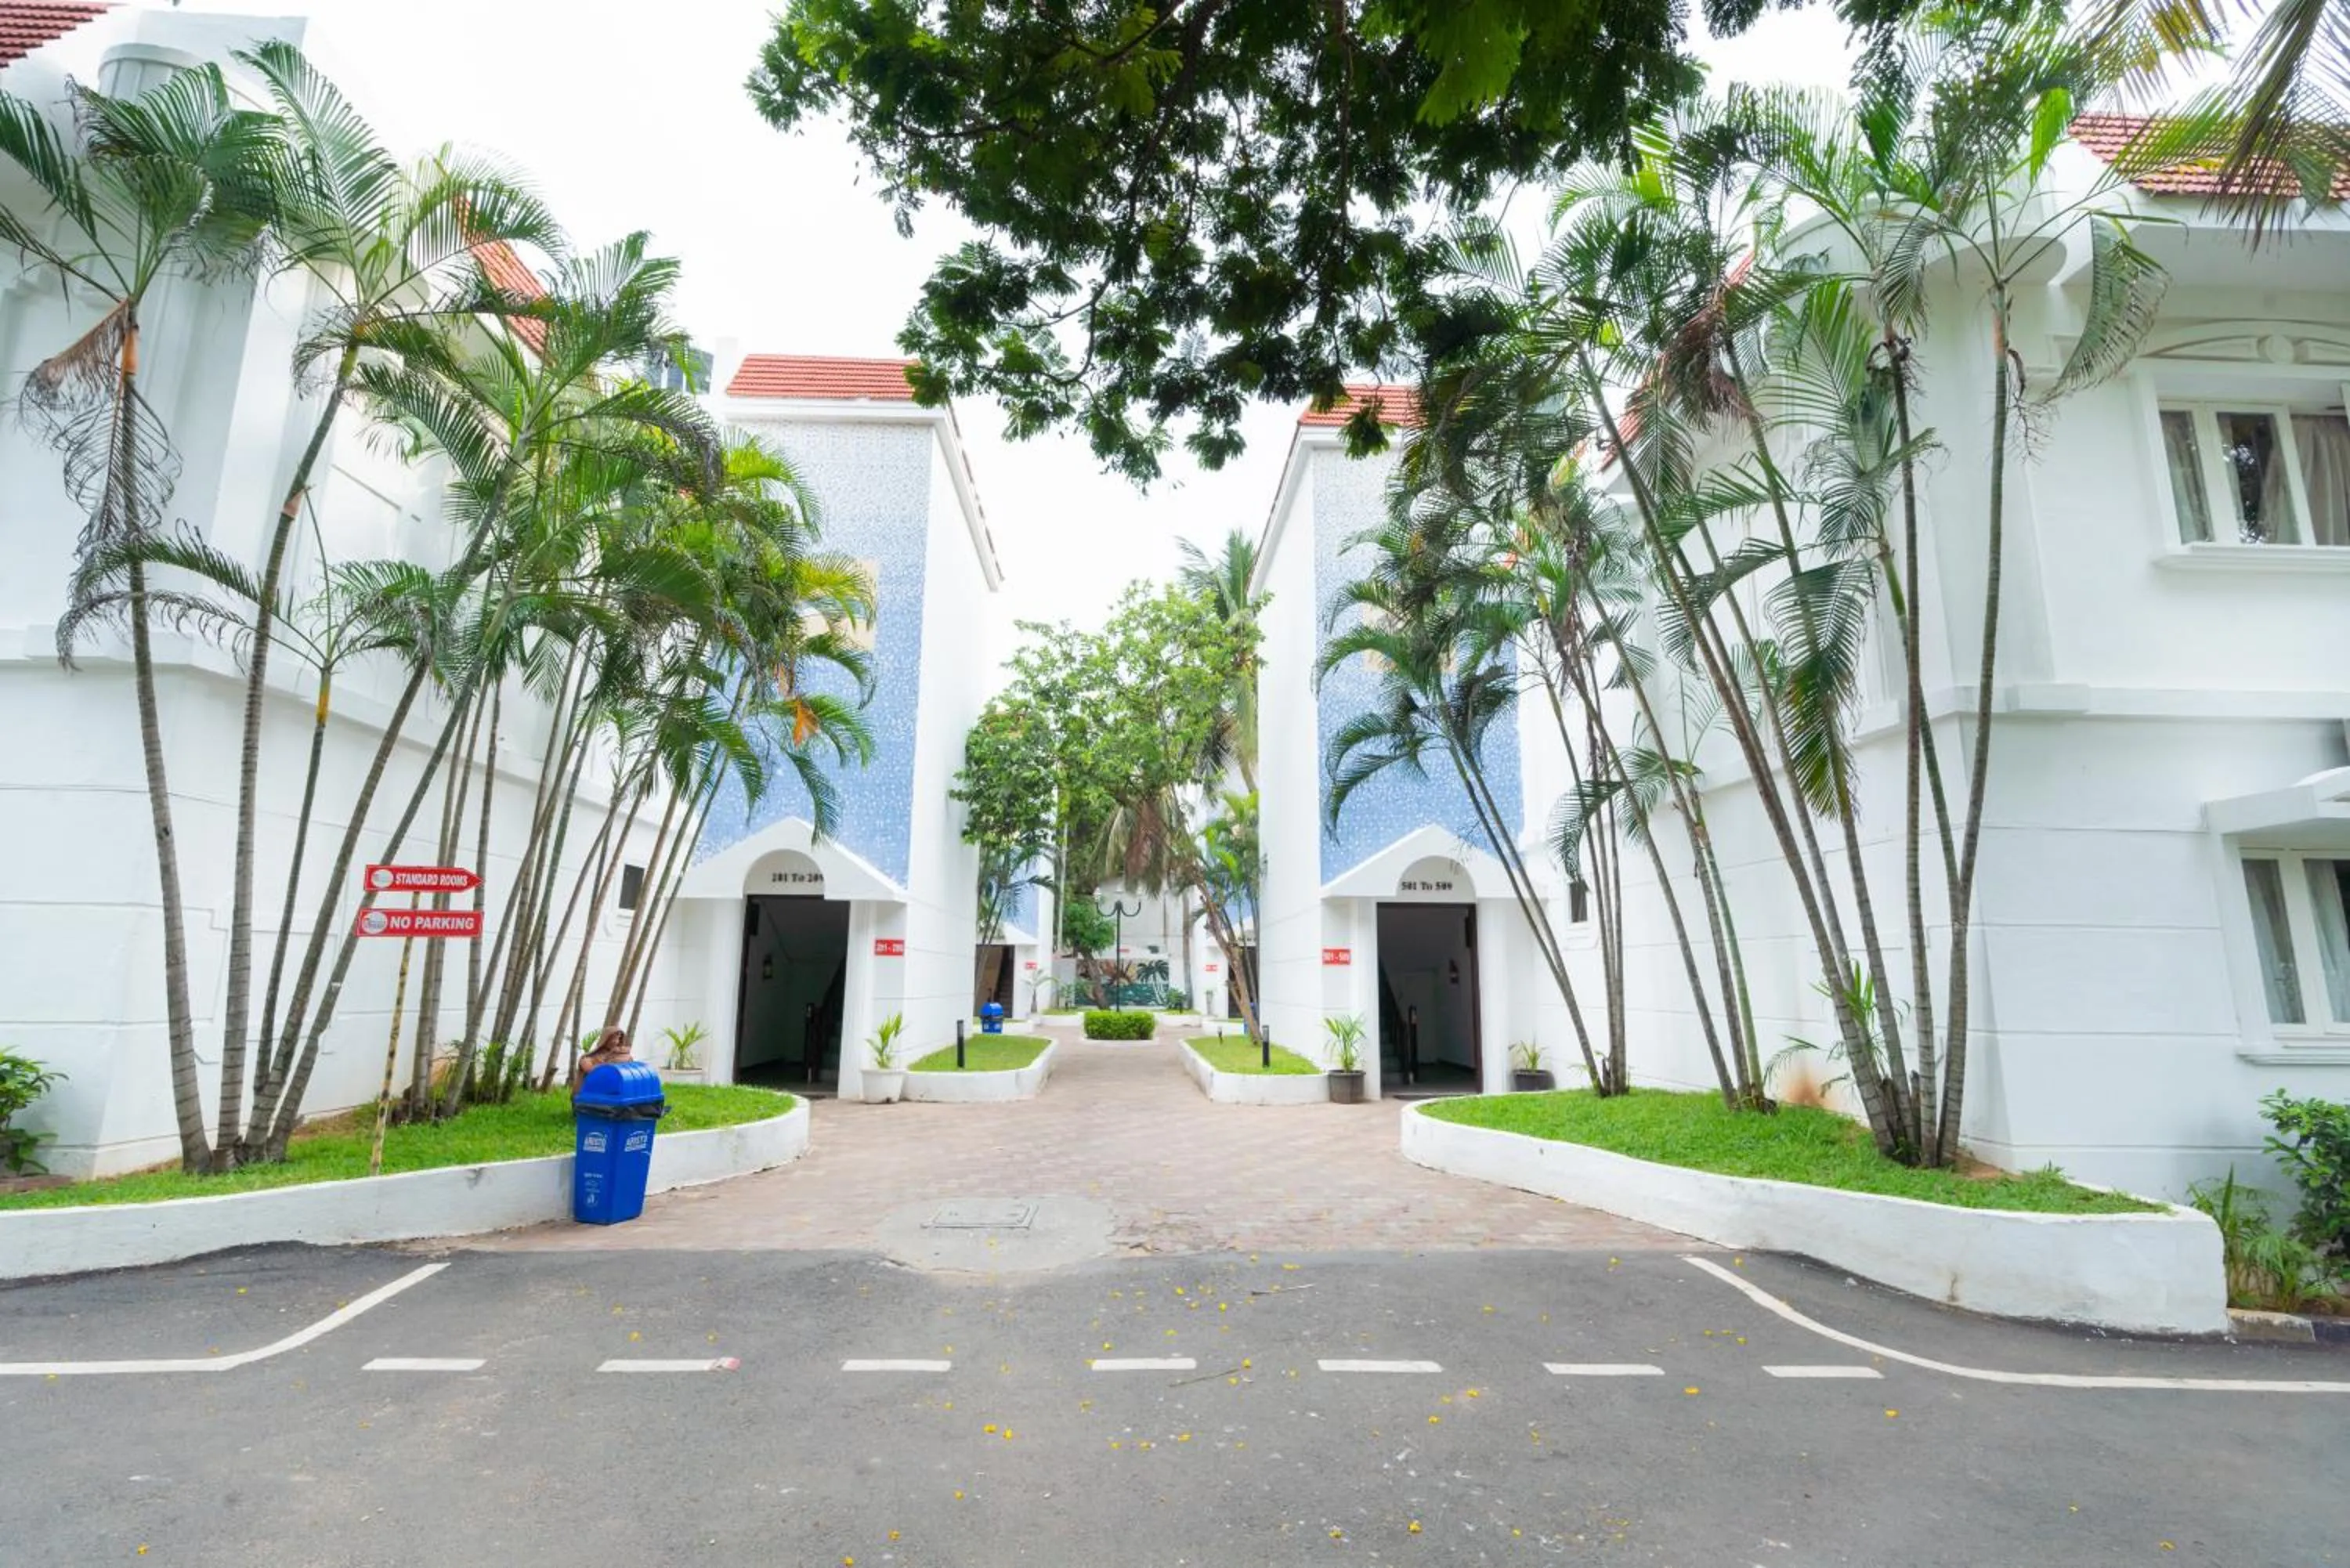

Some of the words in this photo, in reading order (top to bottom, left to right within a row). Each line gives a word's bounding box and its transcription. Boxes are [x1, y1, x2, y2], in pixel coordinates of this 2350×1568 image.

[396, 873, 438, 886] STANDARD
[439, 874, 468, 887] ROOMS
[772, 872, 787, 883] 201
[1401, 881, 1417, 891] 501
[390, 916, 411, 929] NO
[414, 916, 475, 930] PARKING
